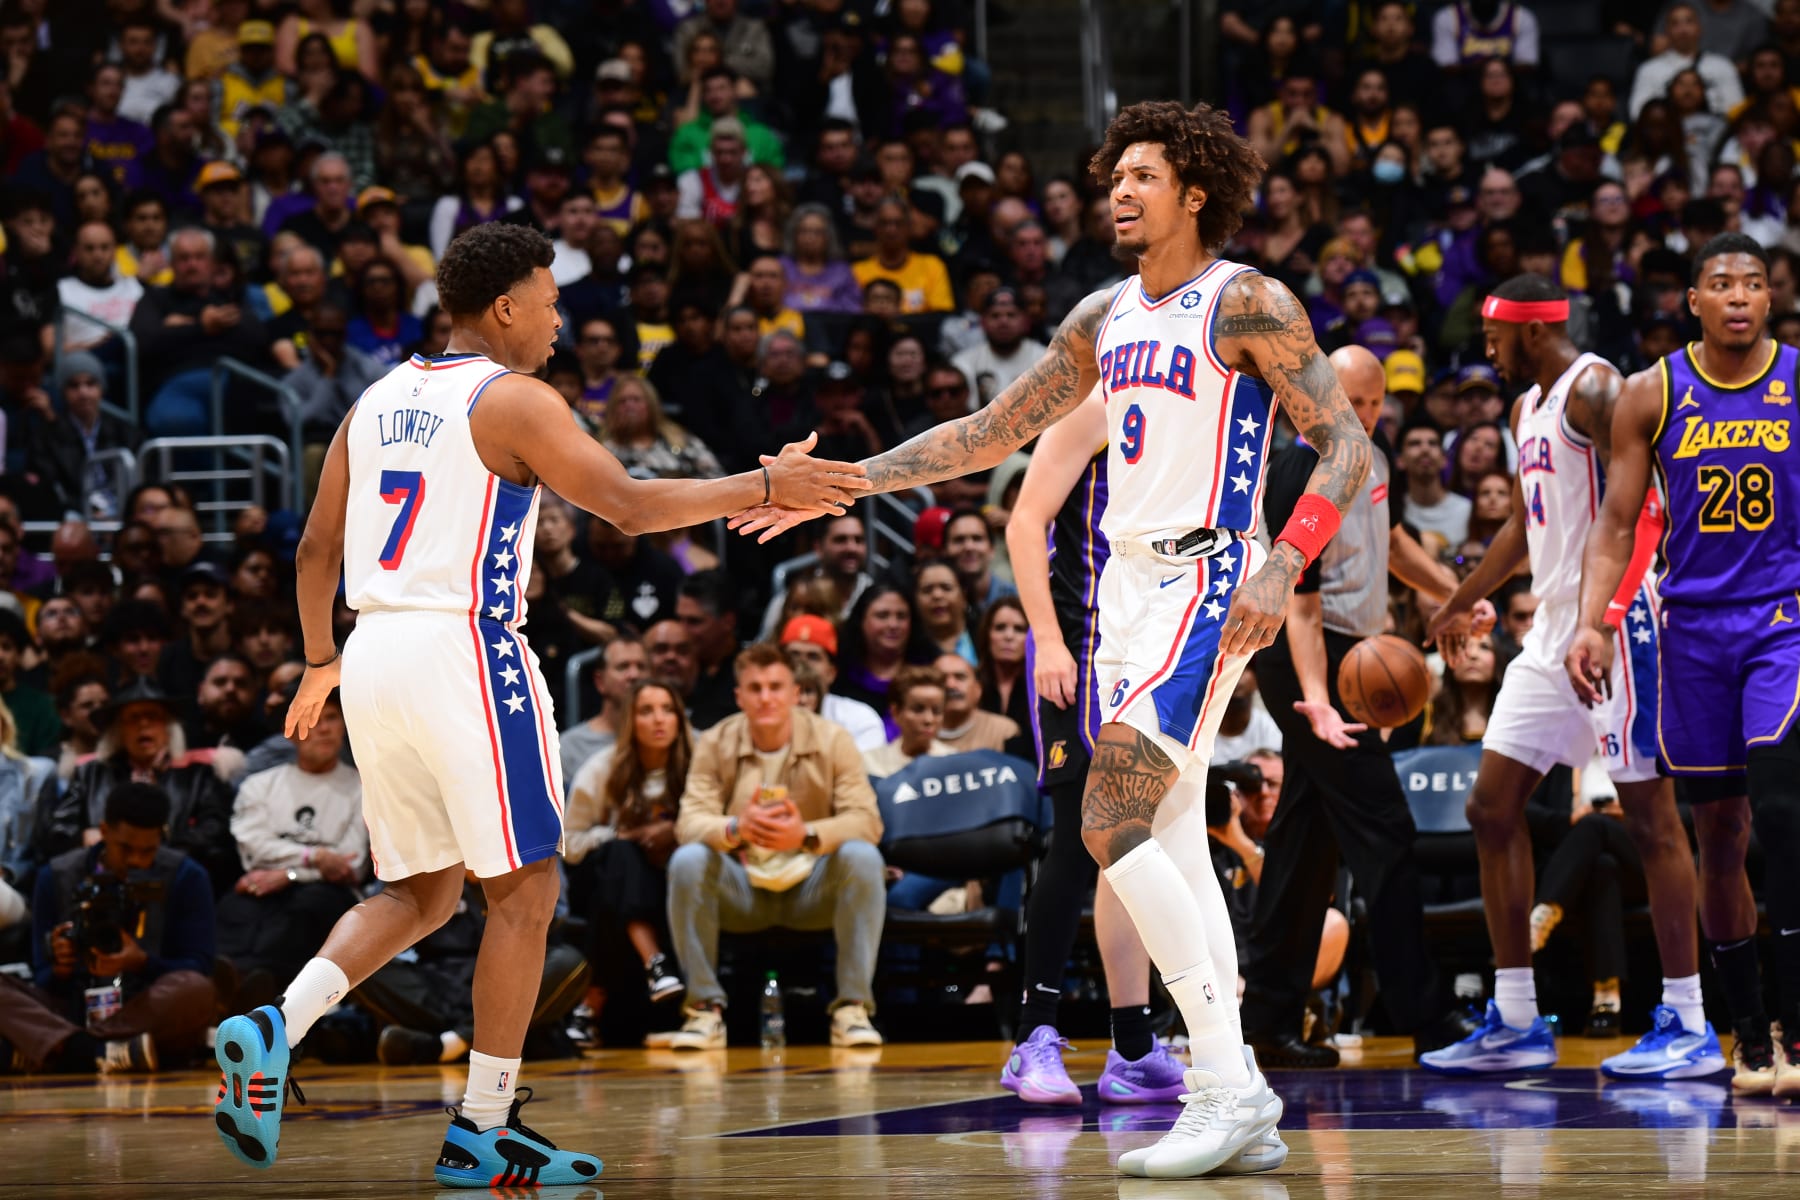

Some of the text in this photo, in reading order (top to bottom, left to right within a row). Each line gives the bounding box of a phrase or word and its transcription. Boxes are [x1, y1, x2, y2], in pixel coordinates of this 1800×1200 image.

[1100, 340, 1197, 403] PHILA
[378, 409, 444, 448] LOWRY
[1120, 404, 1147, 464] 9
[1672, 416, 1791, 459] LAKERS
[378, 470, 426, 570] 7
[1526, 482, 1546, 530] 4
[1697, 463, 1775, 533] 28
[1110, 678, 1130, 708] 6
[922, 766, 1018, 797] DELTA
